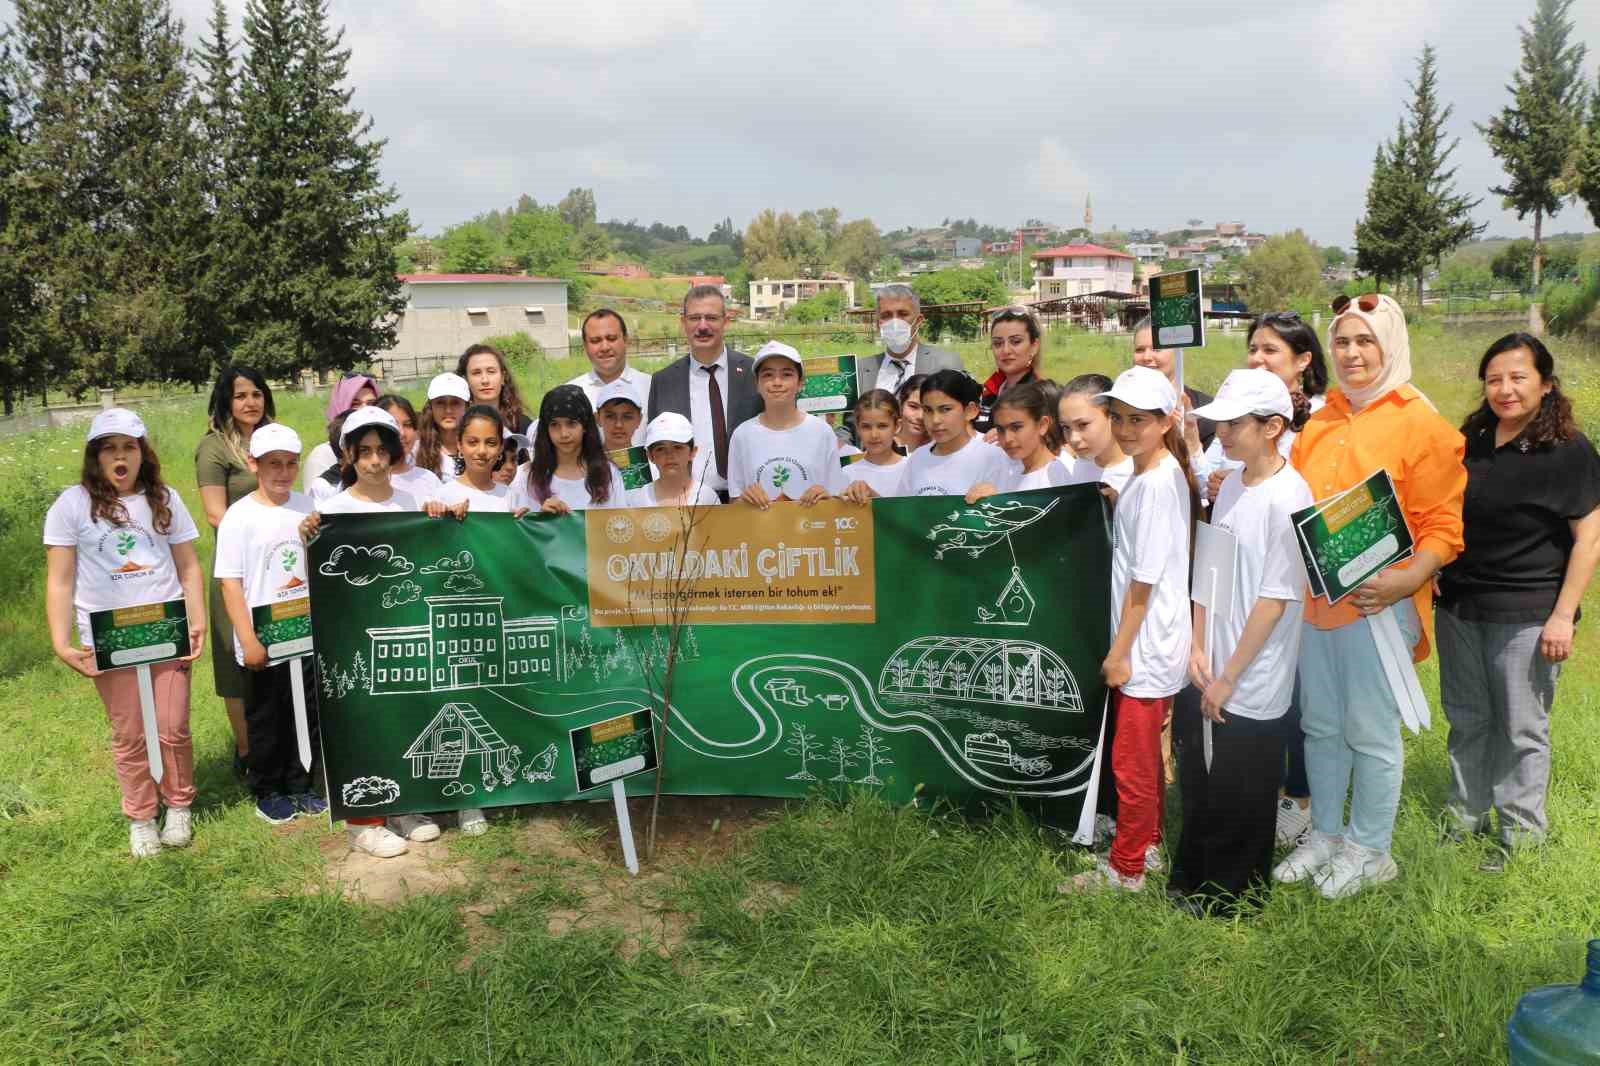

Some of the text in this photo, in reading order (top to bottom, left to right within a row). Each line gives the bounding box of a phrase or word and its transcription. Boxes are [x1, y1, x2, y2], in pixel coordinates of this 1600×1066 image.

[607, 537, 860, 584] OKULDAKİ ÇİFTLİK
[679, 586, 721, 602] görmek
[724, 587, 765, 599] istersen
[768, 584, 783, 597] bir
[786, 585, 819, 598] tohum
